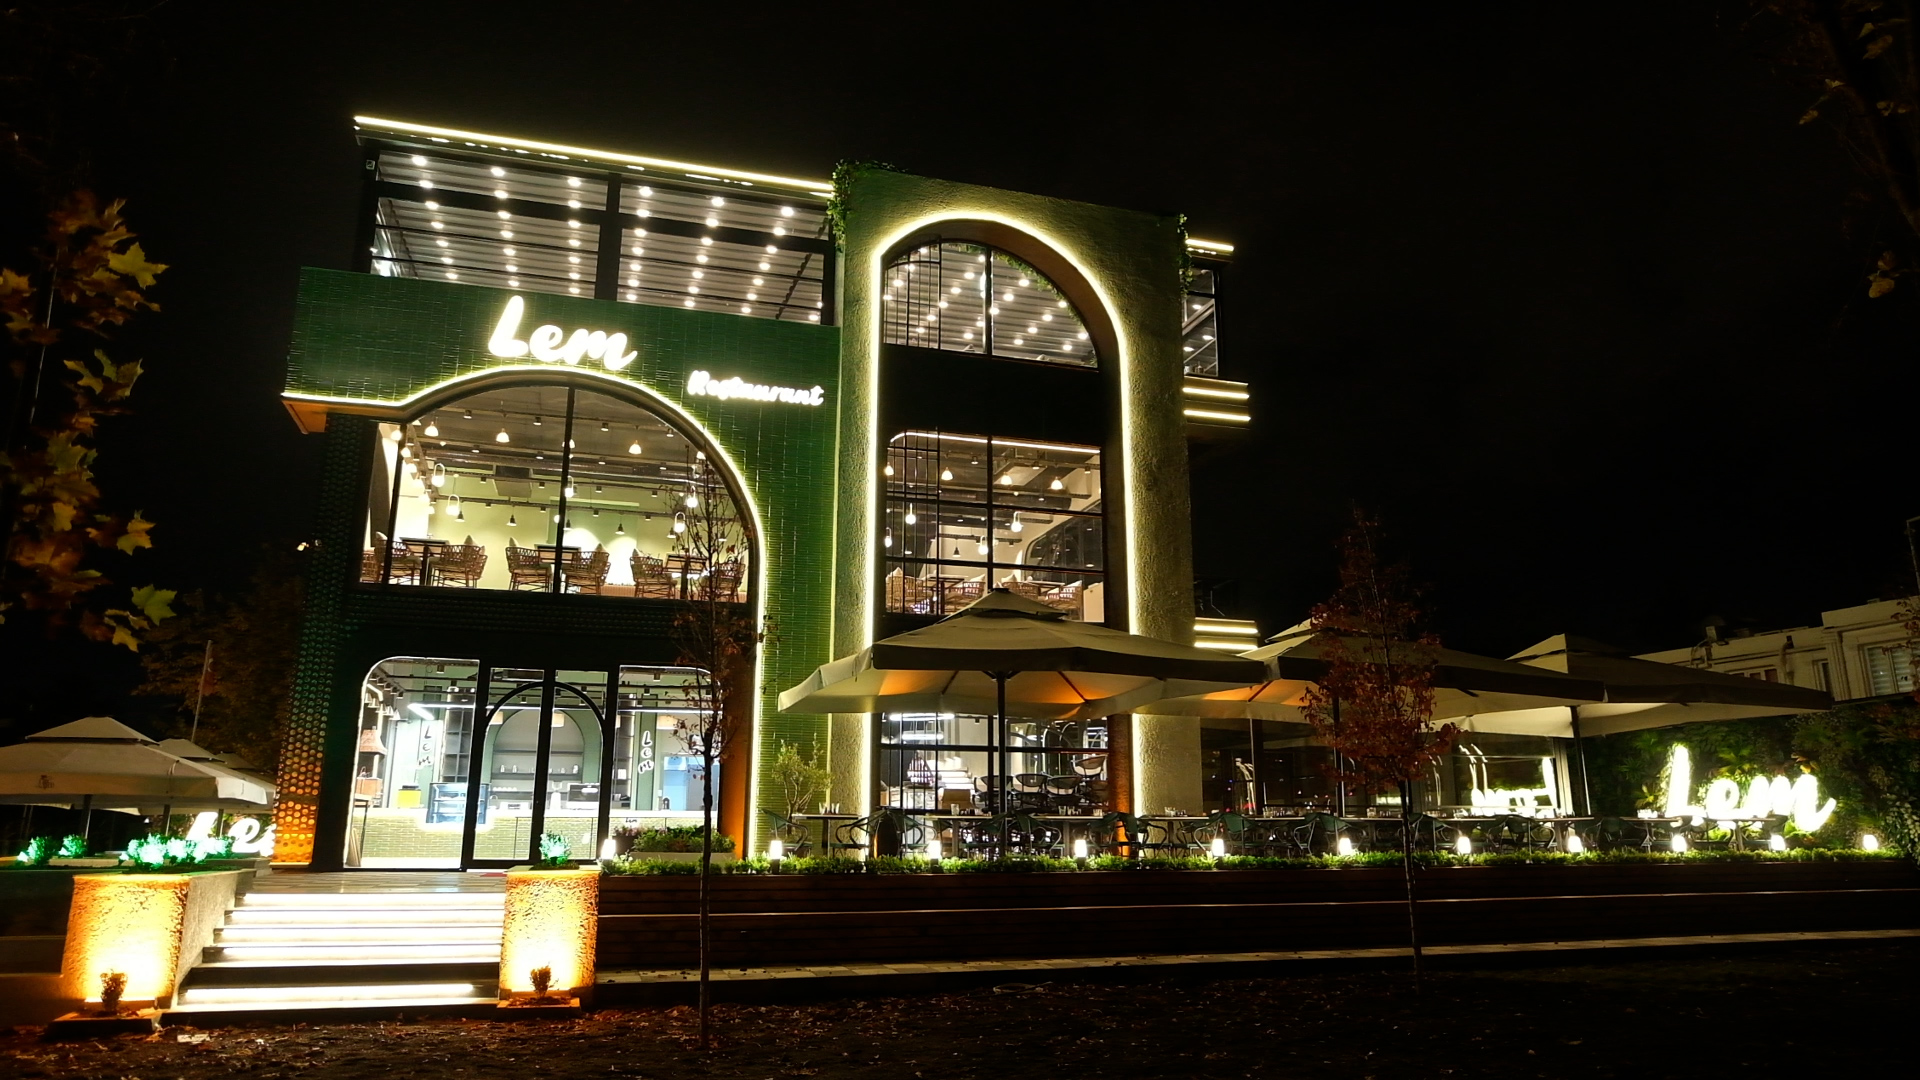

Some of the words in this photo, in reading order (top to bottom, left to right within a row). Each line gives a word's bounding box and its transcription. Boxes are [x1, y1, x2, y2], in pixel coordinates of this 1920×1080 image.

[488, 295, 637, 370] Lem
[688, 370, 825, 406] Restaurant
[418, 726, 432, 767] Lem
[638, 730, 654, 774] Lem
[1665, 745, 1837, 832] Lem
